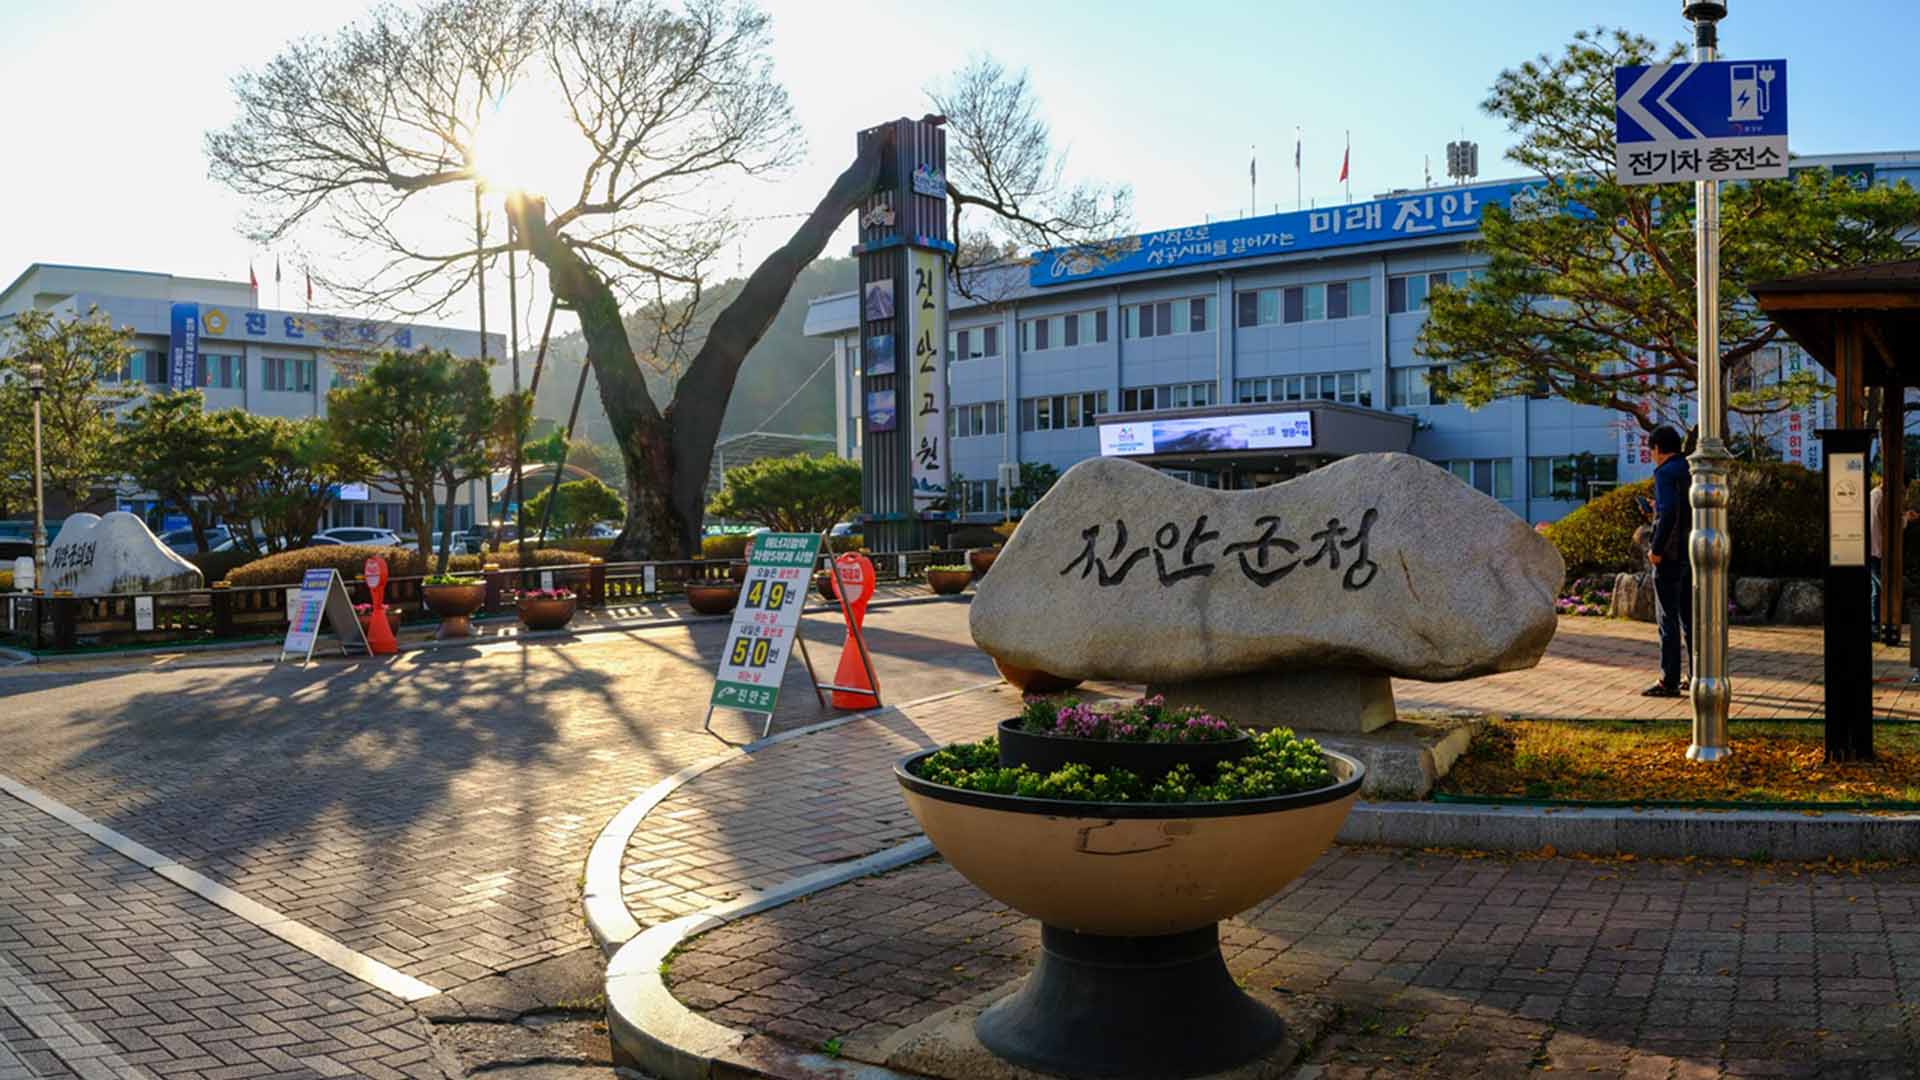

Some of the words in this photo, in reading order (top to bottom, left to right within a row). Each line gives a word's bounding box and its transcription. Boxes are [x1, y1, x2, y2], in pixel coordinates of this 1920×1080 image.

[1628, 149, 1701, 176] 전기차
[1706, 146, 1781, 172] 충전소
[1309, 203, 1381, 234] 미래
[1392, 192, 1479, 233] 진안
[1147, 239, 1227, 264] 성공시대를
[1149, 226, 1210, 245] 시작으로
[915, 267, 939, 470] 진안고원
[1059, 507, 1378, 591] 진안군청
